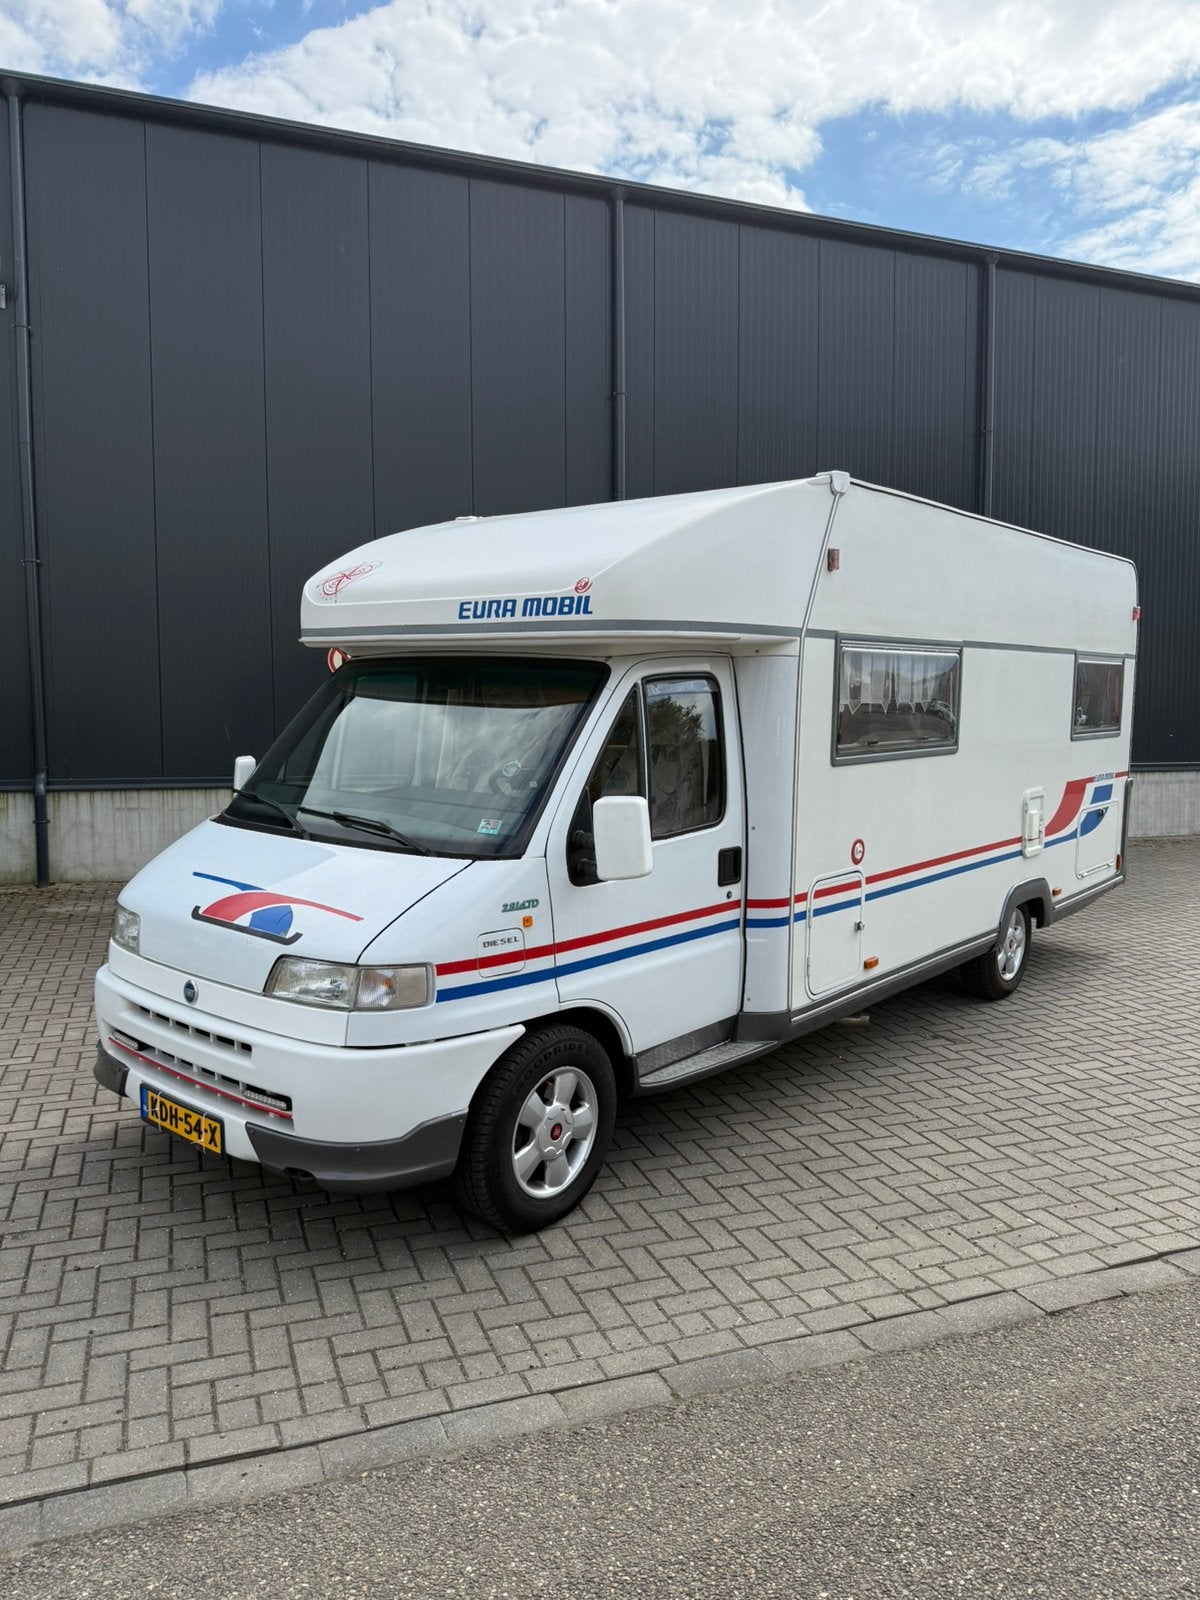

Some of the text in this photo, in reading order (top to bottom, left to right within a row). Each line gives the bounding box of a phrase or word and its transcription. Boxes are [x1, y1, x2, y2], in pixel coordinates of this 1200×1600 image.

[458, 595, 593, 620] EURA MOBIL
[483, 936, 520, 948] DIESEL
[150, 1096, 218, 1148] KDH-54-X
